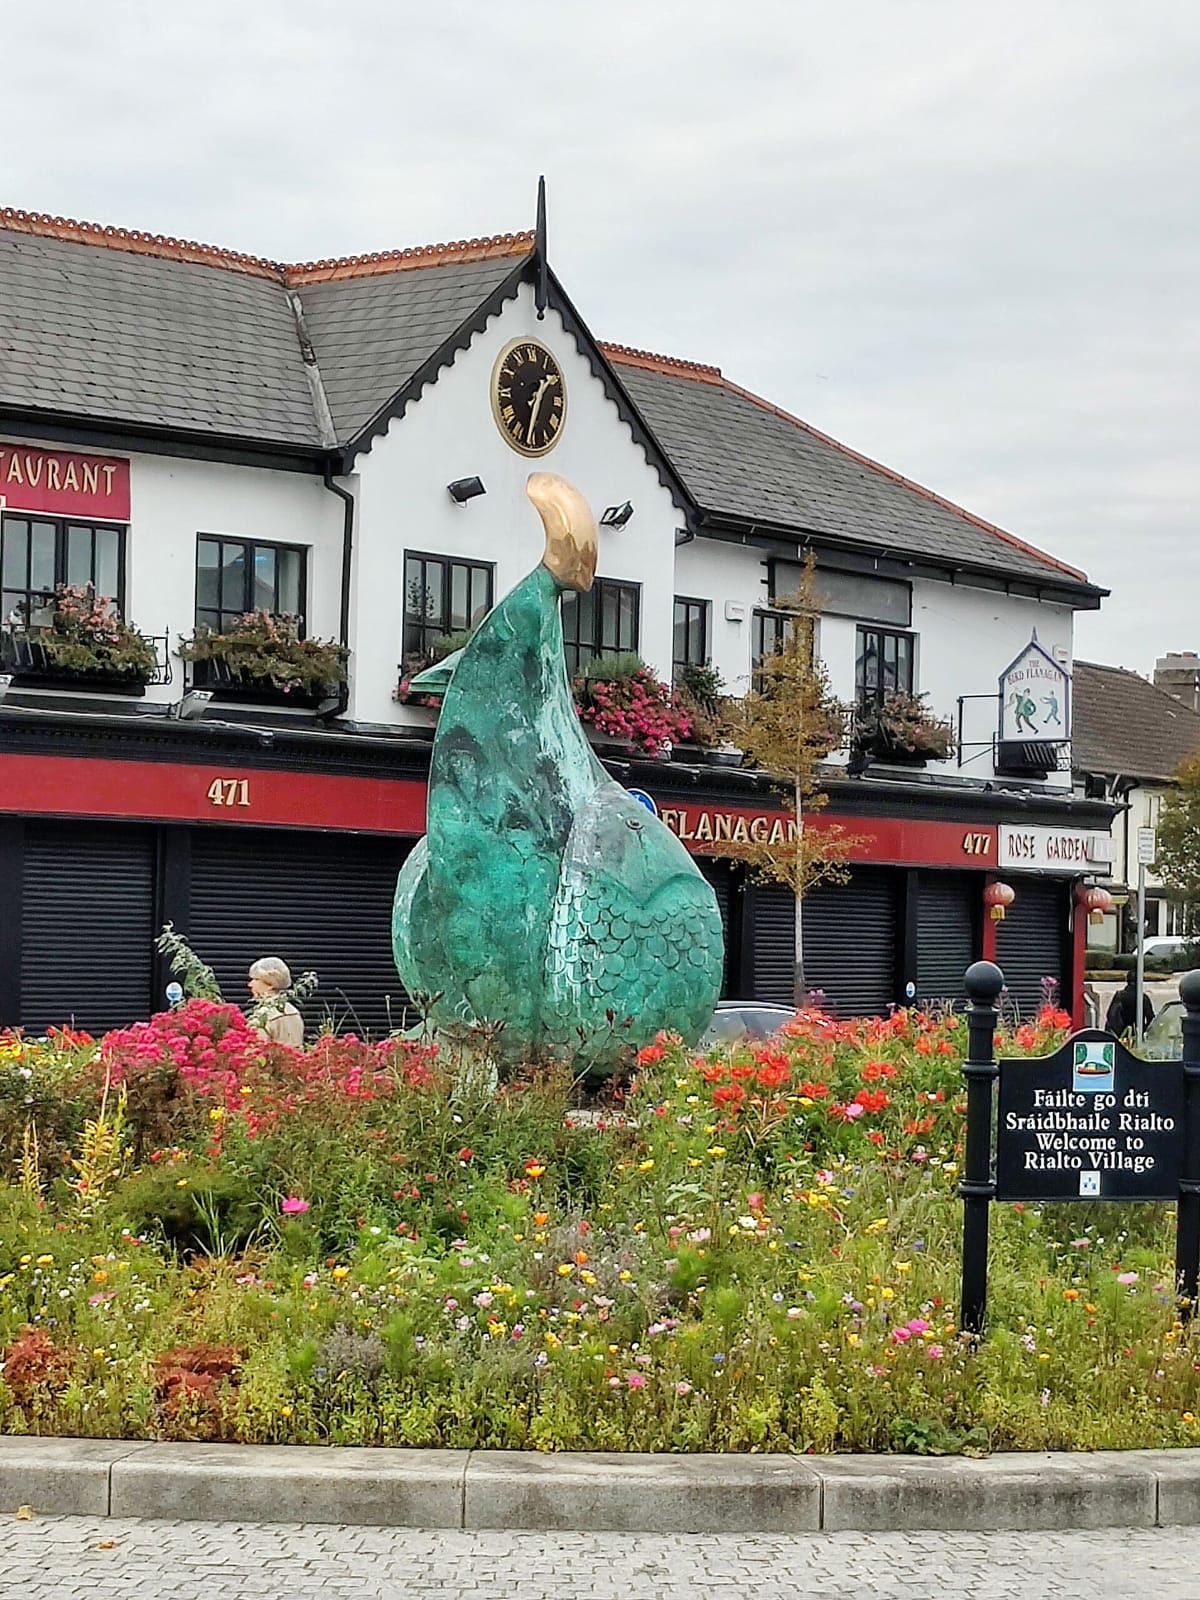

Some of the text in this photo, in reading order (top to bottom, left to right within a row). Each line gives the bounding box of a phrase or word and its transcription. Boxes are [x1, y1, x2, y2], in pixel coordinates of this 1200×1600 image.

[207, 778, 251, 806] 471
[660, 808, 804, 845] FLANAGAN
[963, 833, 991, 855] 477
[1008, 834, 1089, 861] ROSE GARDEN
[1033, 1089, 1150, 1111] Fáilte go dtí
[1006, 1112, 1175, 1130] Sráidbhaile Rialto
[1036, 1132, 1144, 1150] Welcome to
[1024, 1151, 1155, 1173] Rialto Village
